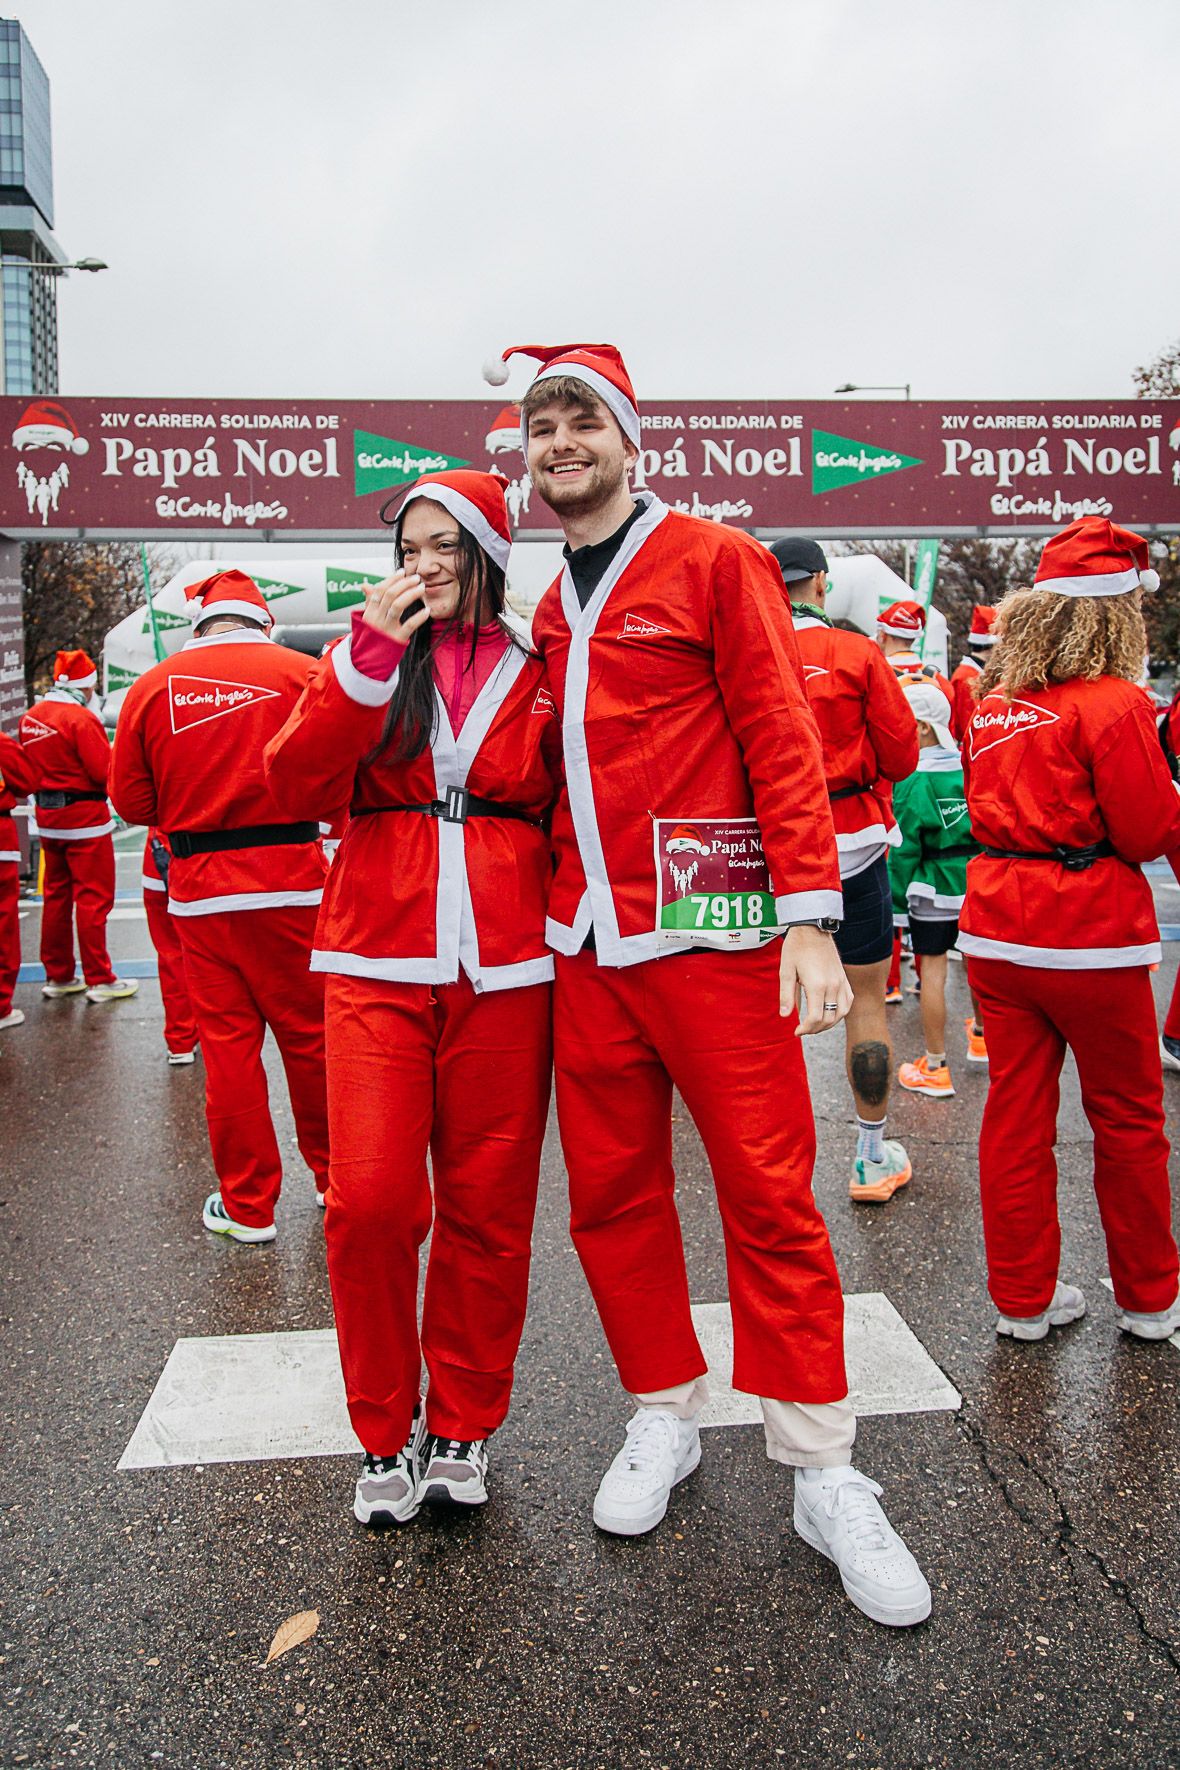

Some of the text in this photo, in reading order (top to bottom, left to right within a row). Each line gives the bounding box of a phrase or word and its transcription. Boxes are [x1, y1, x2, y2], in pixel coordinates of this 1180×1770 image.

[101, 413, 339, 429] XIV CARRERA SOLIDARIA DE
[640, 415, 803, 429] RERA SOLIDARIA DE
[942, 415, 1162, 429] XIV CARRERA SOLIDARIA DE
[101, 436, 341, 488] Papá Noel
[628, 436, 804, 488] pá Noel
[941, 436, 1162, 487] Papá Noel
[186, 692, 214, 705] Corte
[214, 687, 253, 707] Inglés
[710, 838, 747, 858] Papá
[690, 894, 763, 928] 7918
